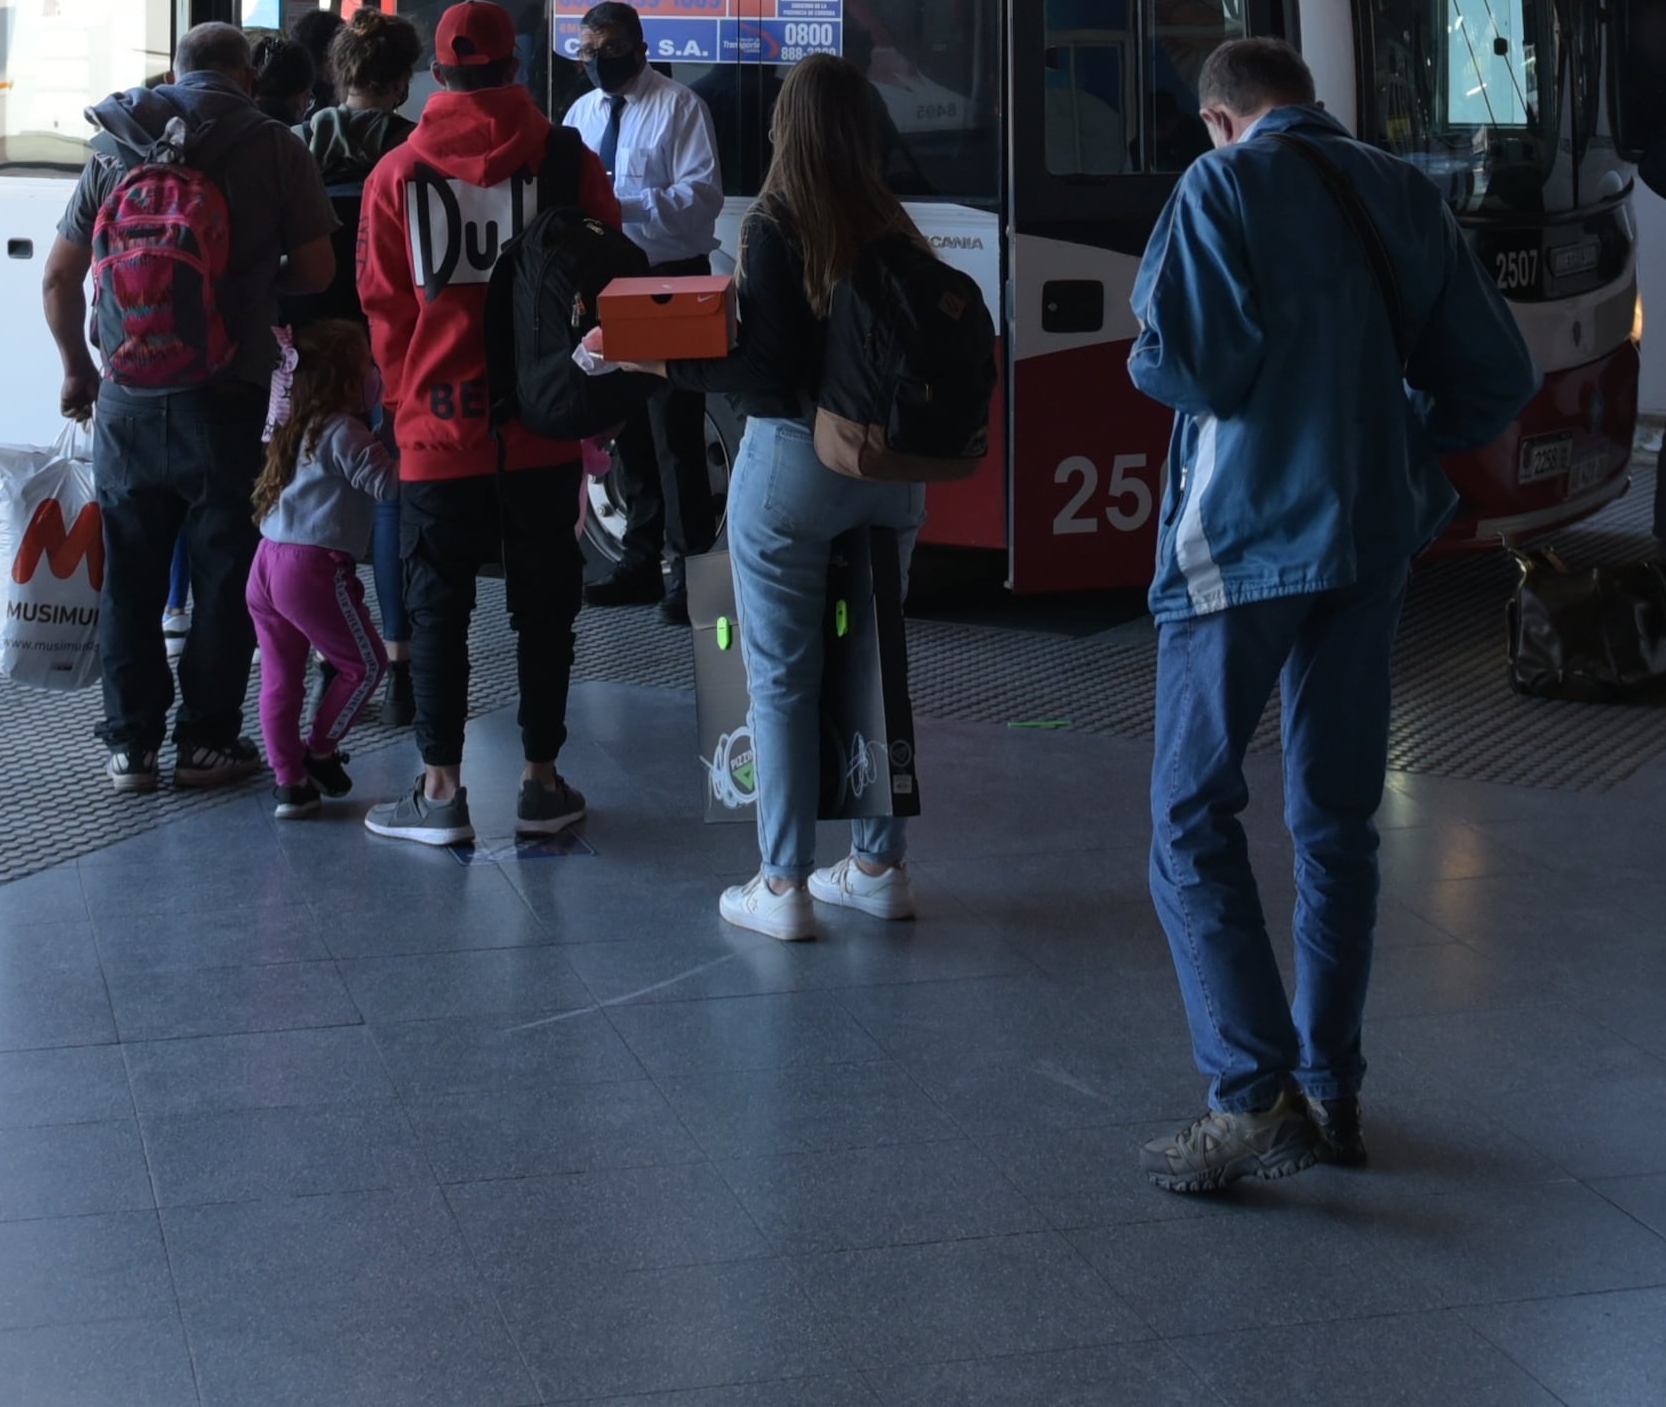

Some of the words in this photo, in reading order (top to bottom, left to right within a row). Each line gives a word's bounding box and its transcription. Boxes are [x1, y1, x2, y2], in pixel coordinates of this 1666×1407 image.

[784, 23, 833, 46] 0800
[657, 38, 710, 56] S.A.
[926, 235, 984, 250] CANIA
[1495, 248, 1539, 290] 2507
[1052, 452, 1168, 536] 25
